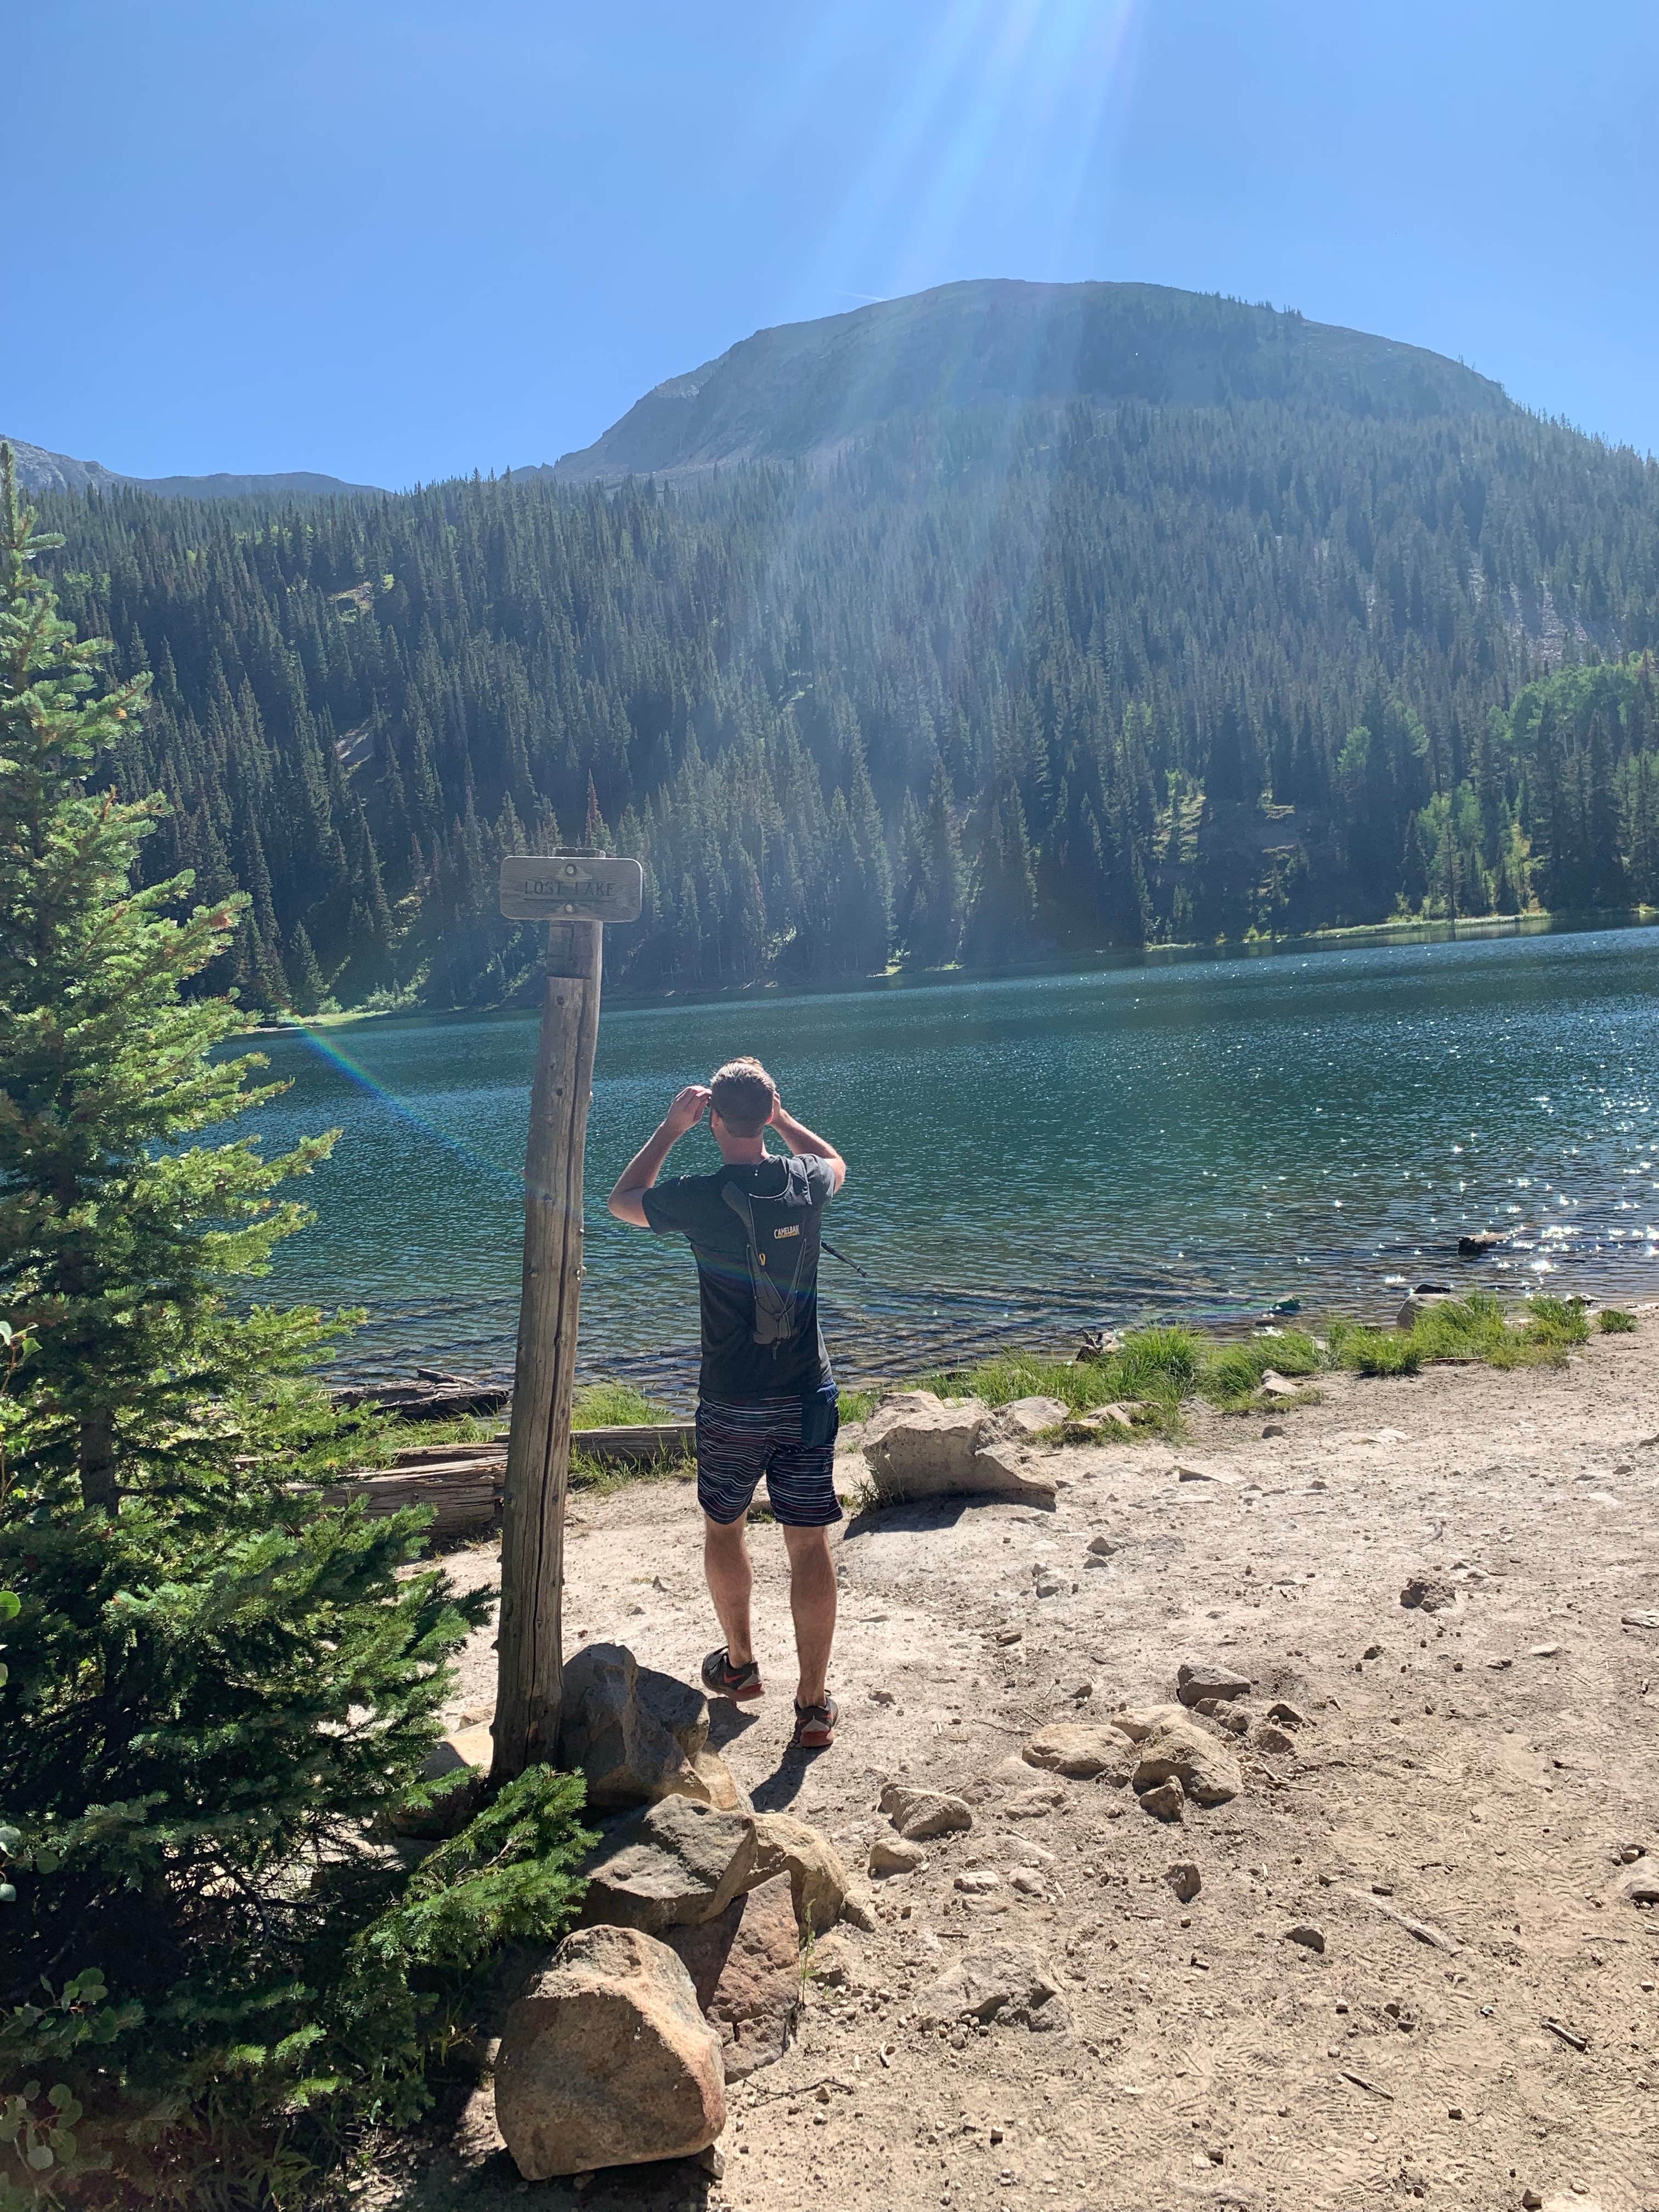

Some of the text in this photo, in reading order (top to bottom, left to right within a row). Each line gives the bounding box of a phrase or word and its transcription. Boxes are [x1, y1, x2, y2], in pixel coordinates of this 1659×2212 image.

[524, 881, 616, 896] LOST LAKE
[774, 1224, 800, 1239] CAMELBAK
